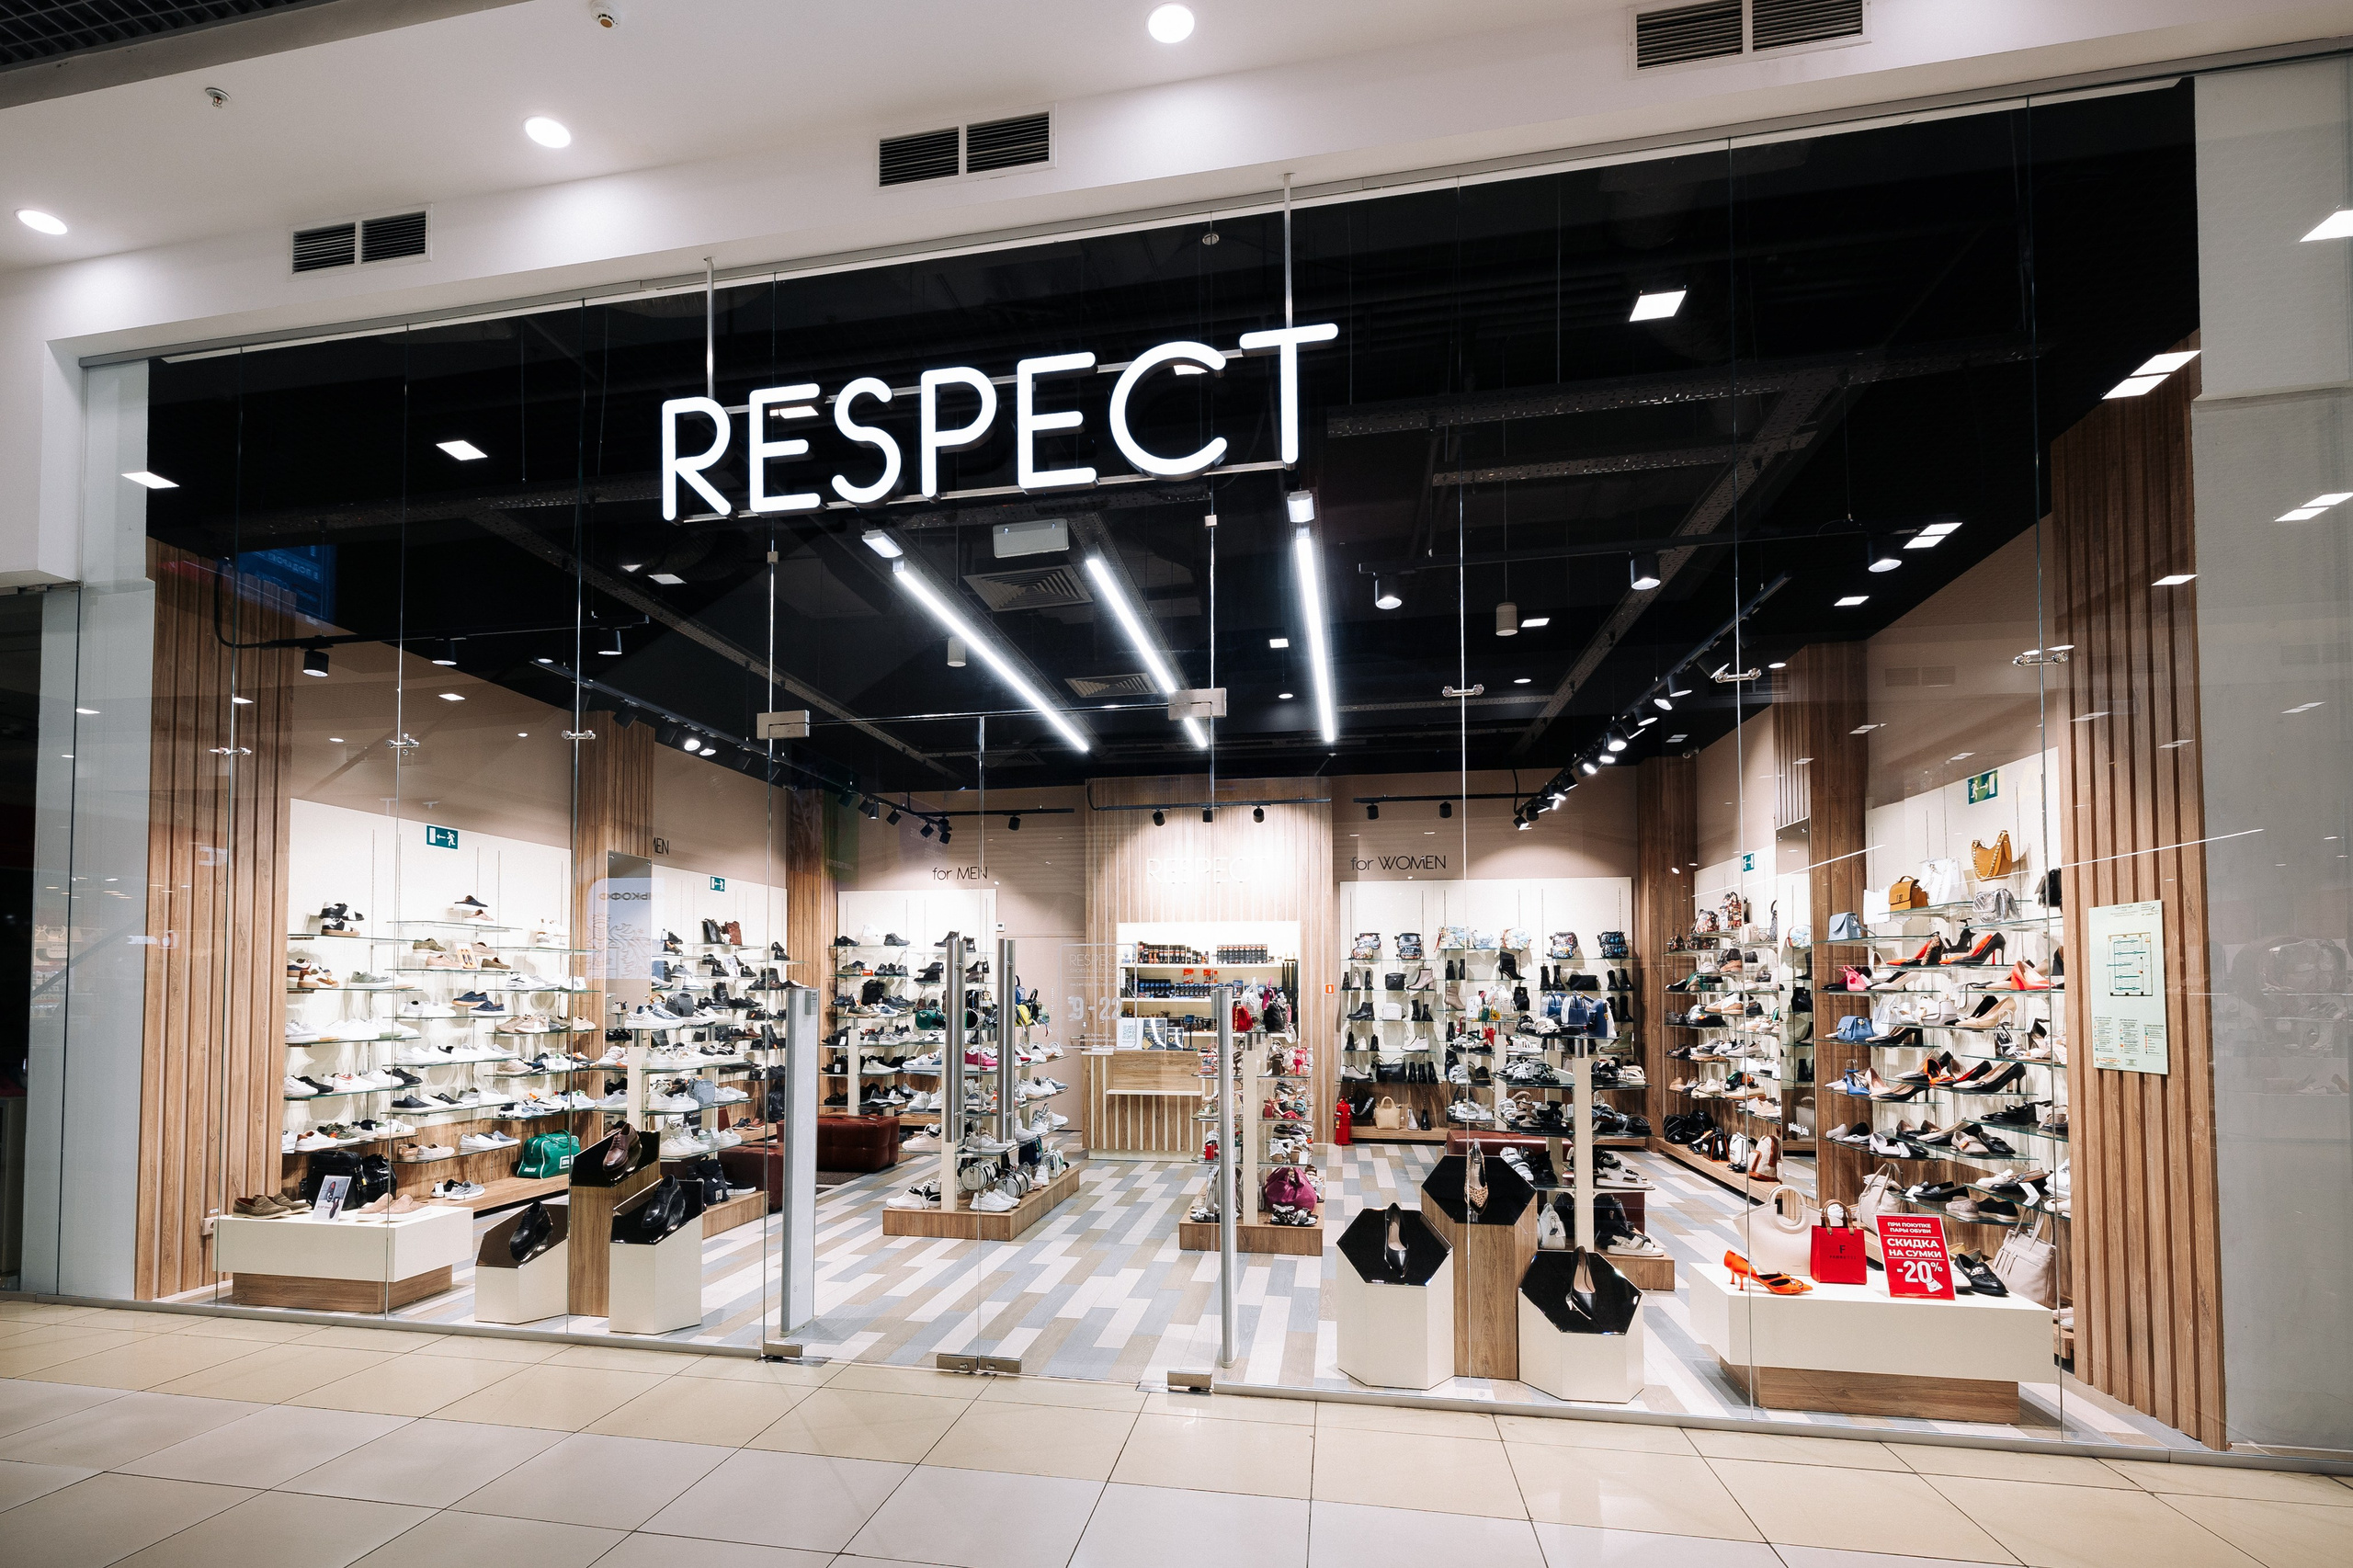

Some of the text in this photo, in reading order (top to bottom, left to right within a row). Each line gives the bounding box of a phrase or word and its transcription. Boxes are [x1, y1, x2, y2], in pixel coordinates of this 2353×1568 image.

[662, 323, 1339, 522] RESPECT
[1146, 856, 1267, 884] RESPECT
[1350, 855, 1447, 871] for WOMEN
[932, 866, 988, 881] for MEN
[1069, 953, 1120, 967] RESPEC
[1839, 1244, 1846, 1254] F
[1886, 1237, 1939, 1248] СКИДКА
[1905, 1249, 1942, 1258] СУМКИ
